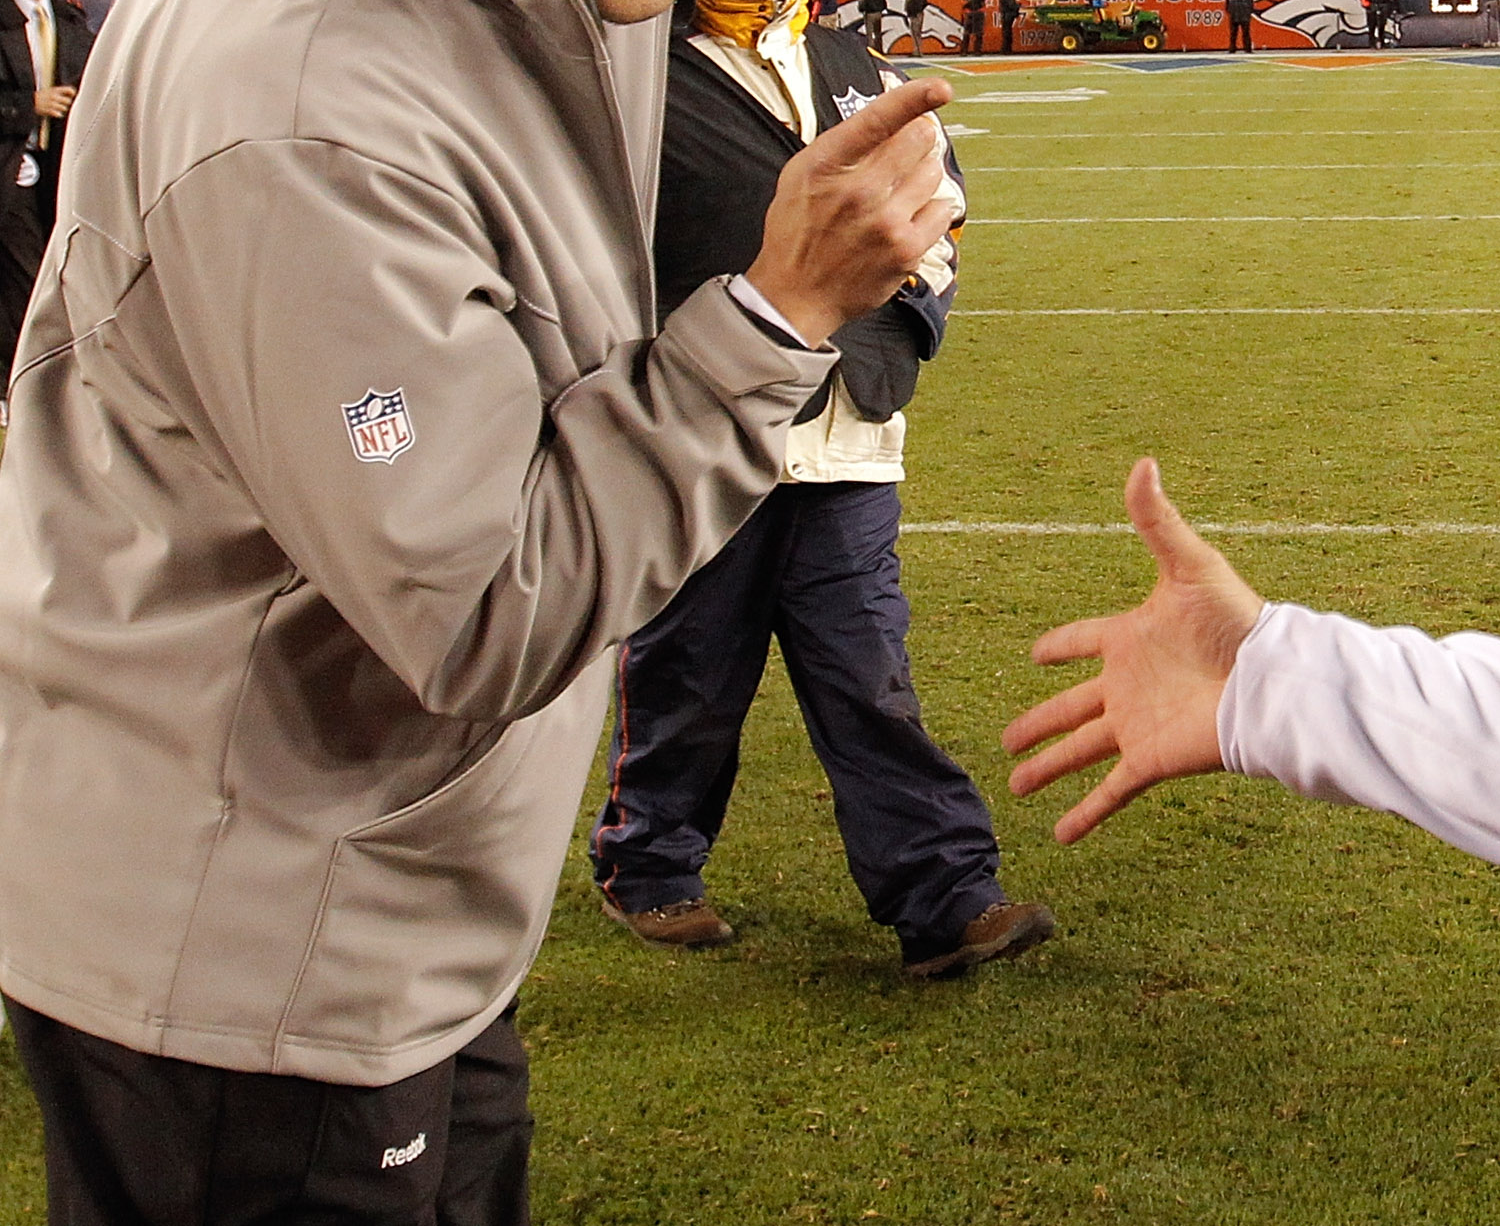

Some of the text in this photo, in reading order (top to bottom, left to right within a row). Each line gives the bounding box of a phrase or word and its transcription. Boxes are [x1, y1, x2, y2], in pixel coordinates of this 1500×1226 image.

[1185, 10, 1224, 26] 1989
[355, 417, 408, 453] NFL
[381, 1132, 427, 1169] Reebok
